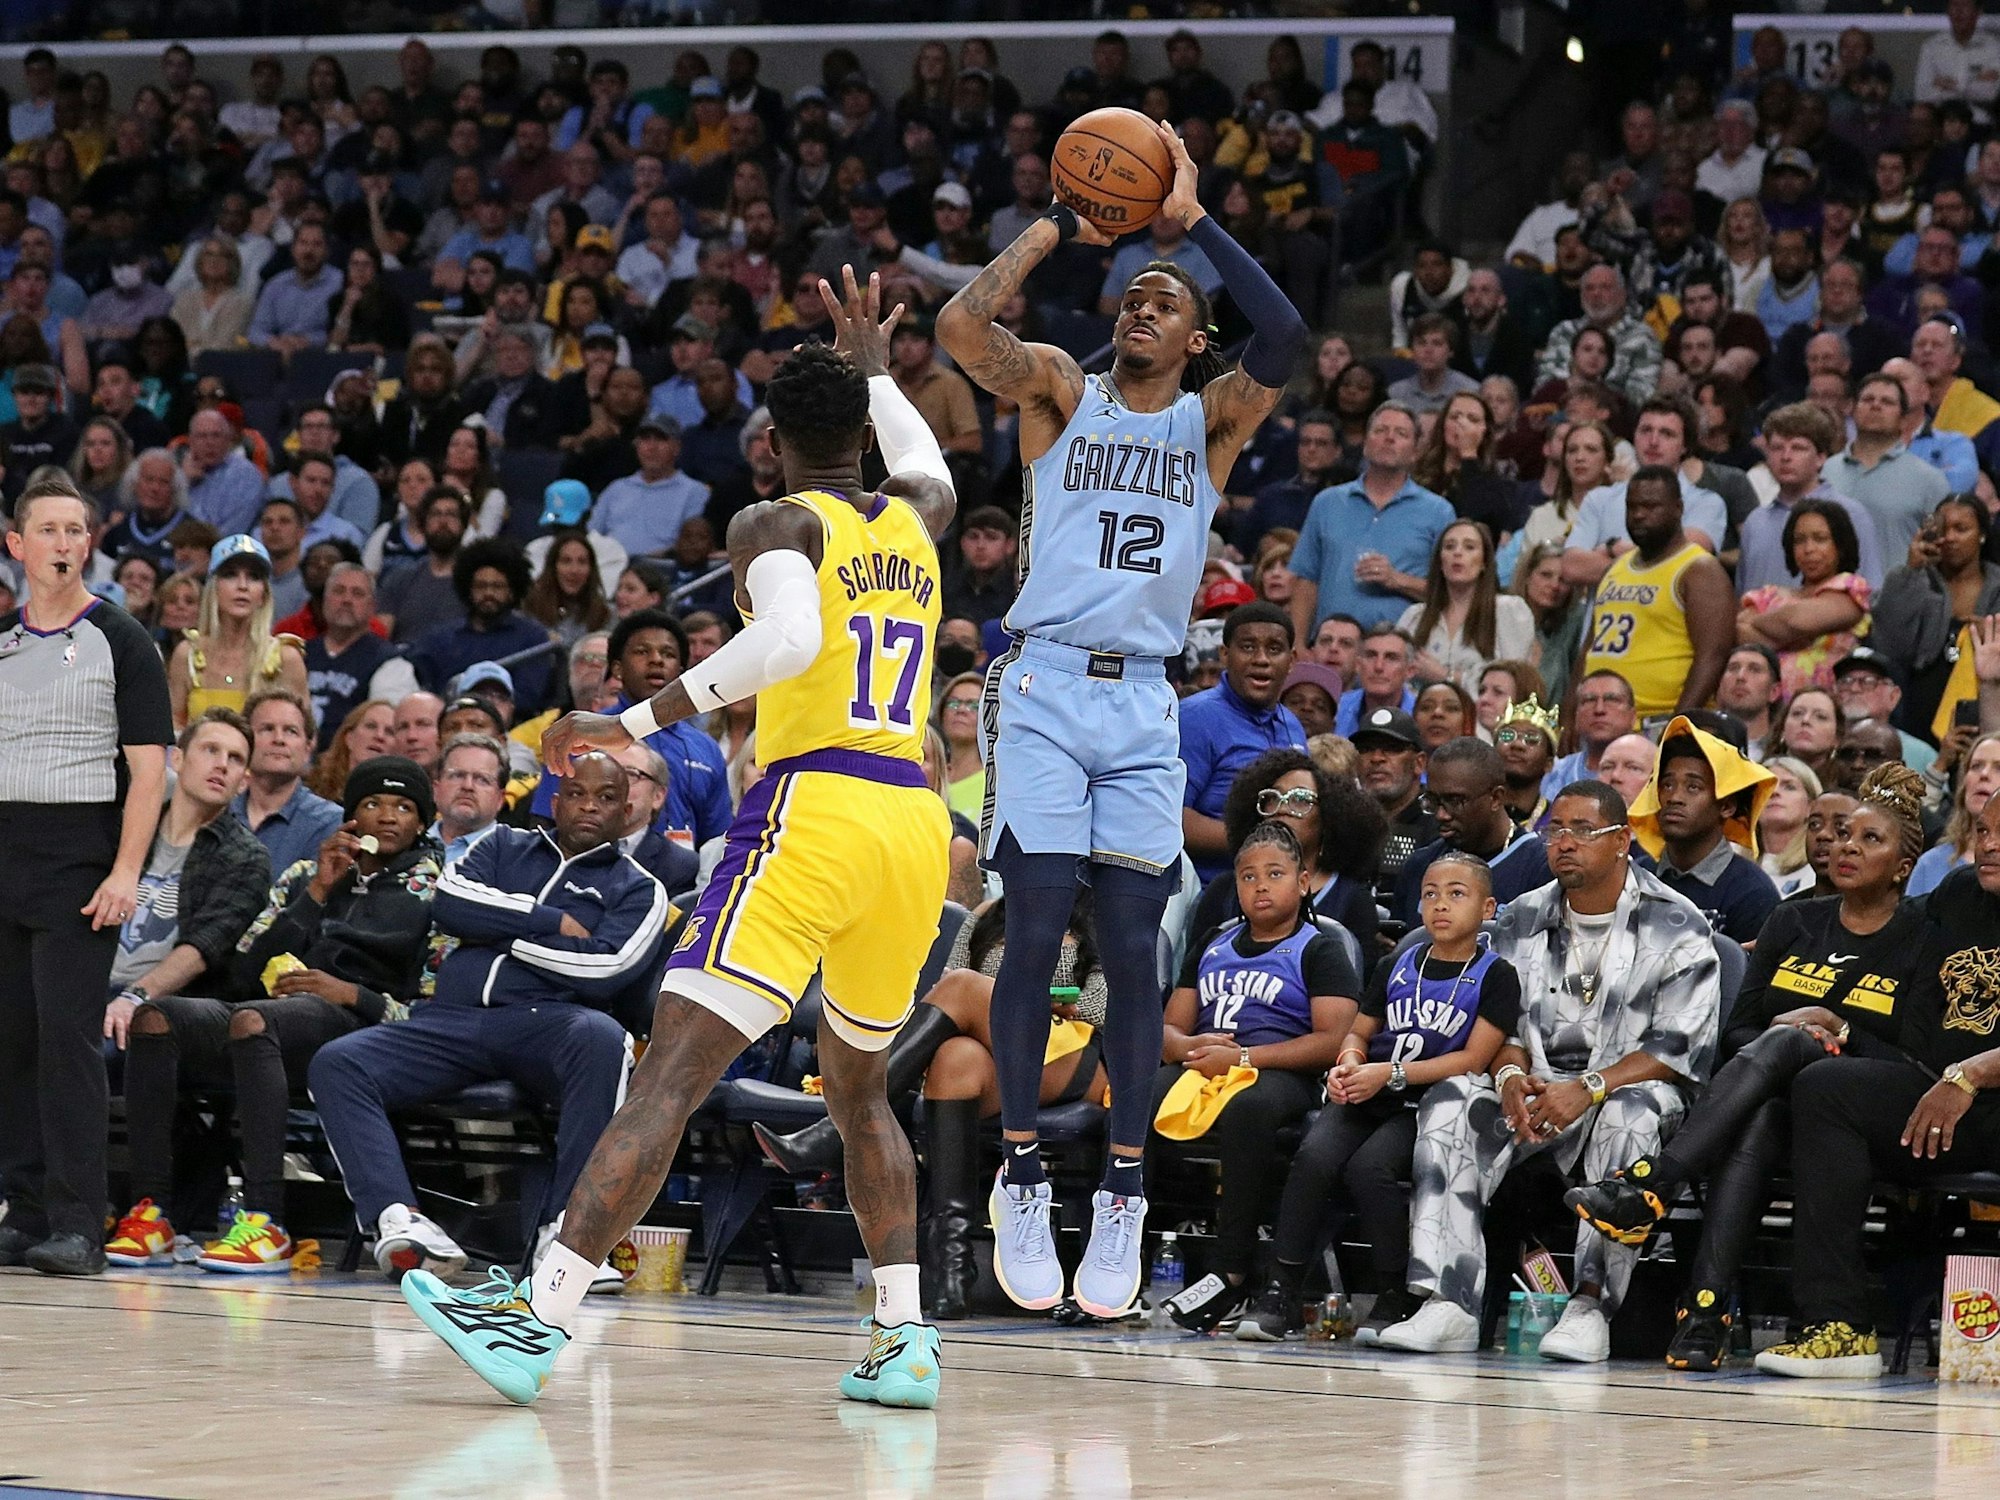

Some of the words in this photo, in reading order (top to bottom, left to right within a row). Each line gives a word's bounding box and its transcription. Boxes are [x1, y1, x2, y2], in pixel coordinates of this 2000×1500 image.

[1383, 45, 1423, 82] 14
[1792, 41, 1834, 80] 13
[1056, 173, 1128, 222] Wilson
[1063, 435, 1197, 508] GRIZZLIES
[1098, 510, 1166, 576] 12
[1591, 612, 1636, 656] 23
[848, 612, 926, 736] 17
[1199, 970, 1285, 1008] ALL-STAR
[1778, 955, 1900, 994] LAKRS
[1793, 978, 1863, 1003] BASKELL
[1213, 993, 1246, 1031] 12
[1386, 997, 1469, 1039] ALL-STAR
[1390, 1032, 1425, 1065] 12
[1534, 1263, 1557, 1294] POP
[1955, 1310, 1999, 1330] CORN
[1958, 1299, 1992, 1316] POP
